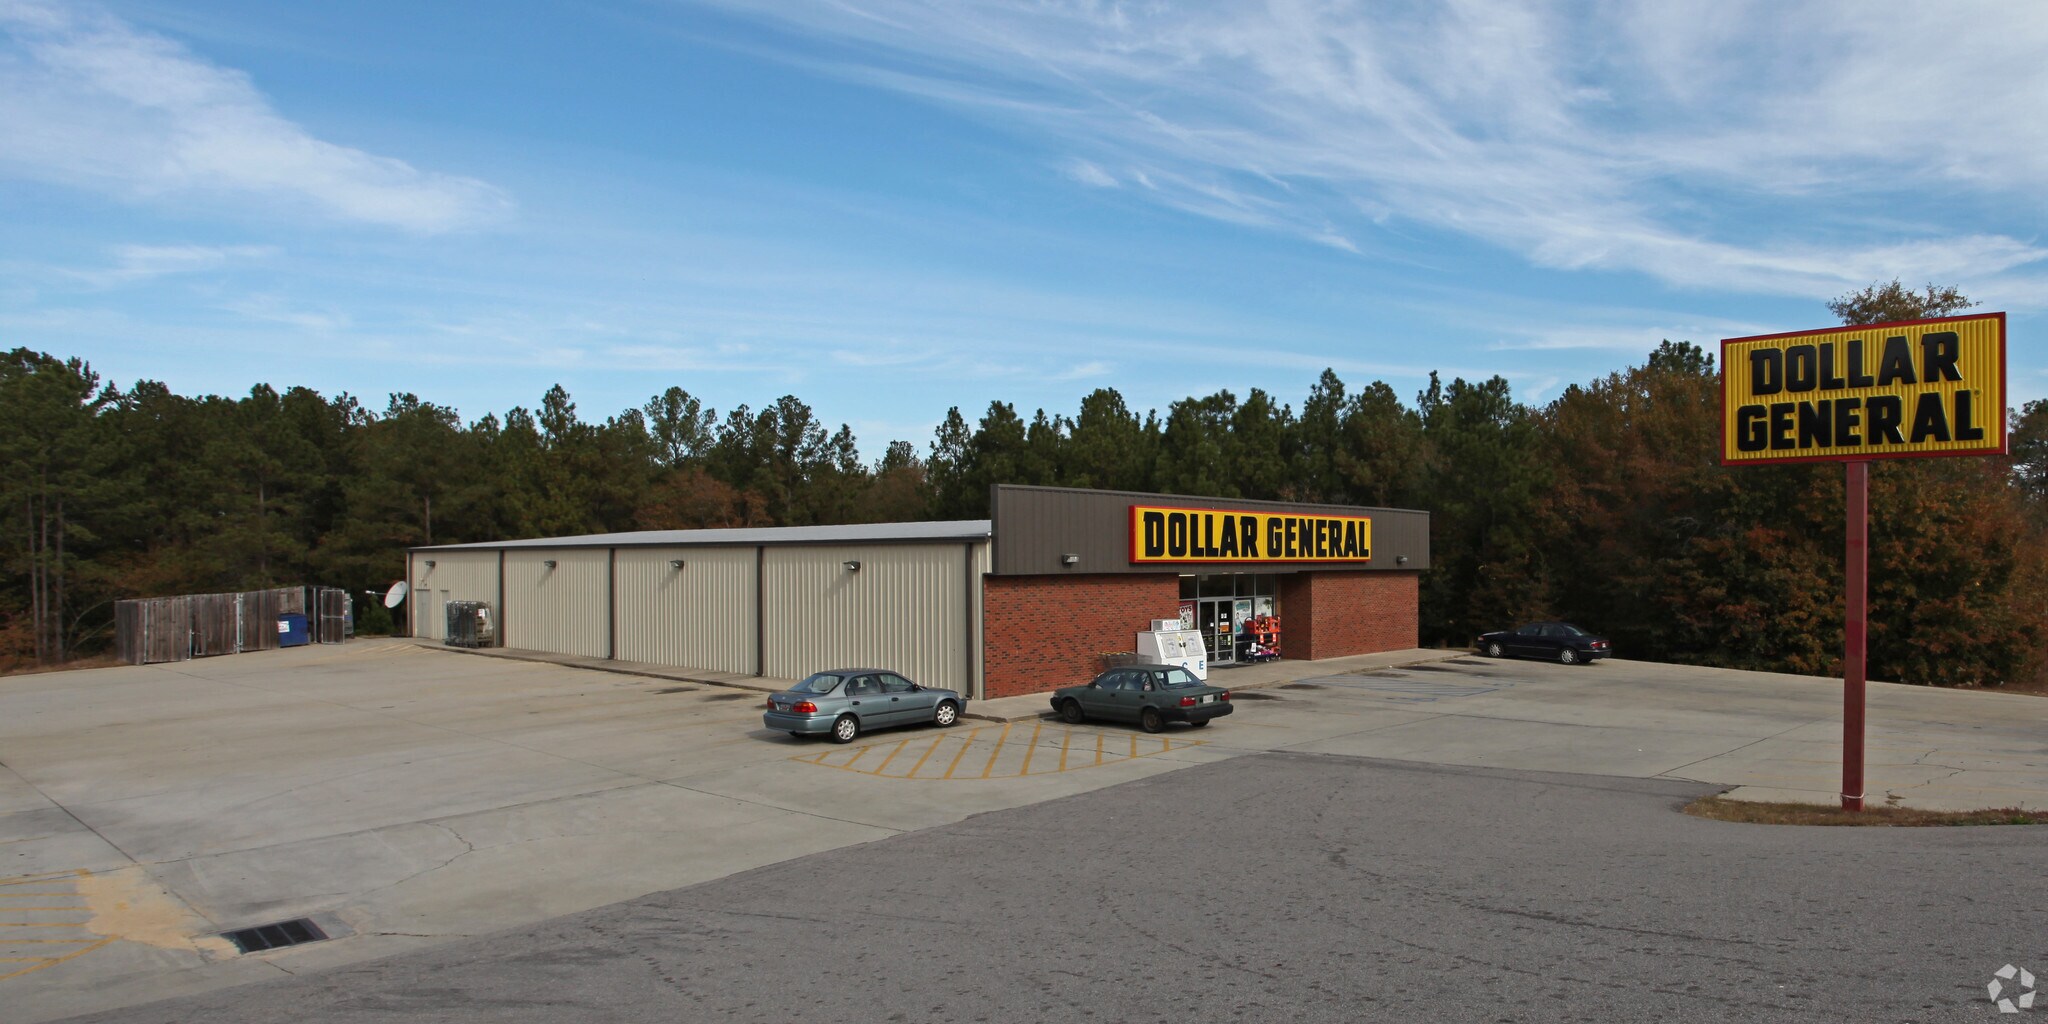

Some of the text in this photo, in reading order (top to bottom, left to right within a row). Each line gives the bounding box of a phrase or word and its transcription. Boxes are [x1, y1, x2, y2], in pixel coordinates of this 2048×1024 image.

[1750, 331, 1963, 396] DOLLAR
[1737, 389, 1984, 450] GENERAL
[1143, 511, 1369, 558] DOLLAR GENERAL
[1167, 660, 1204, 670] CE
